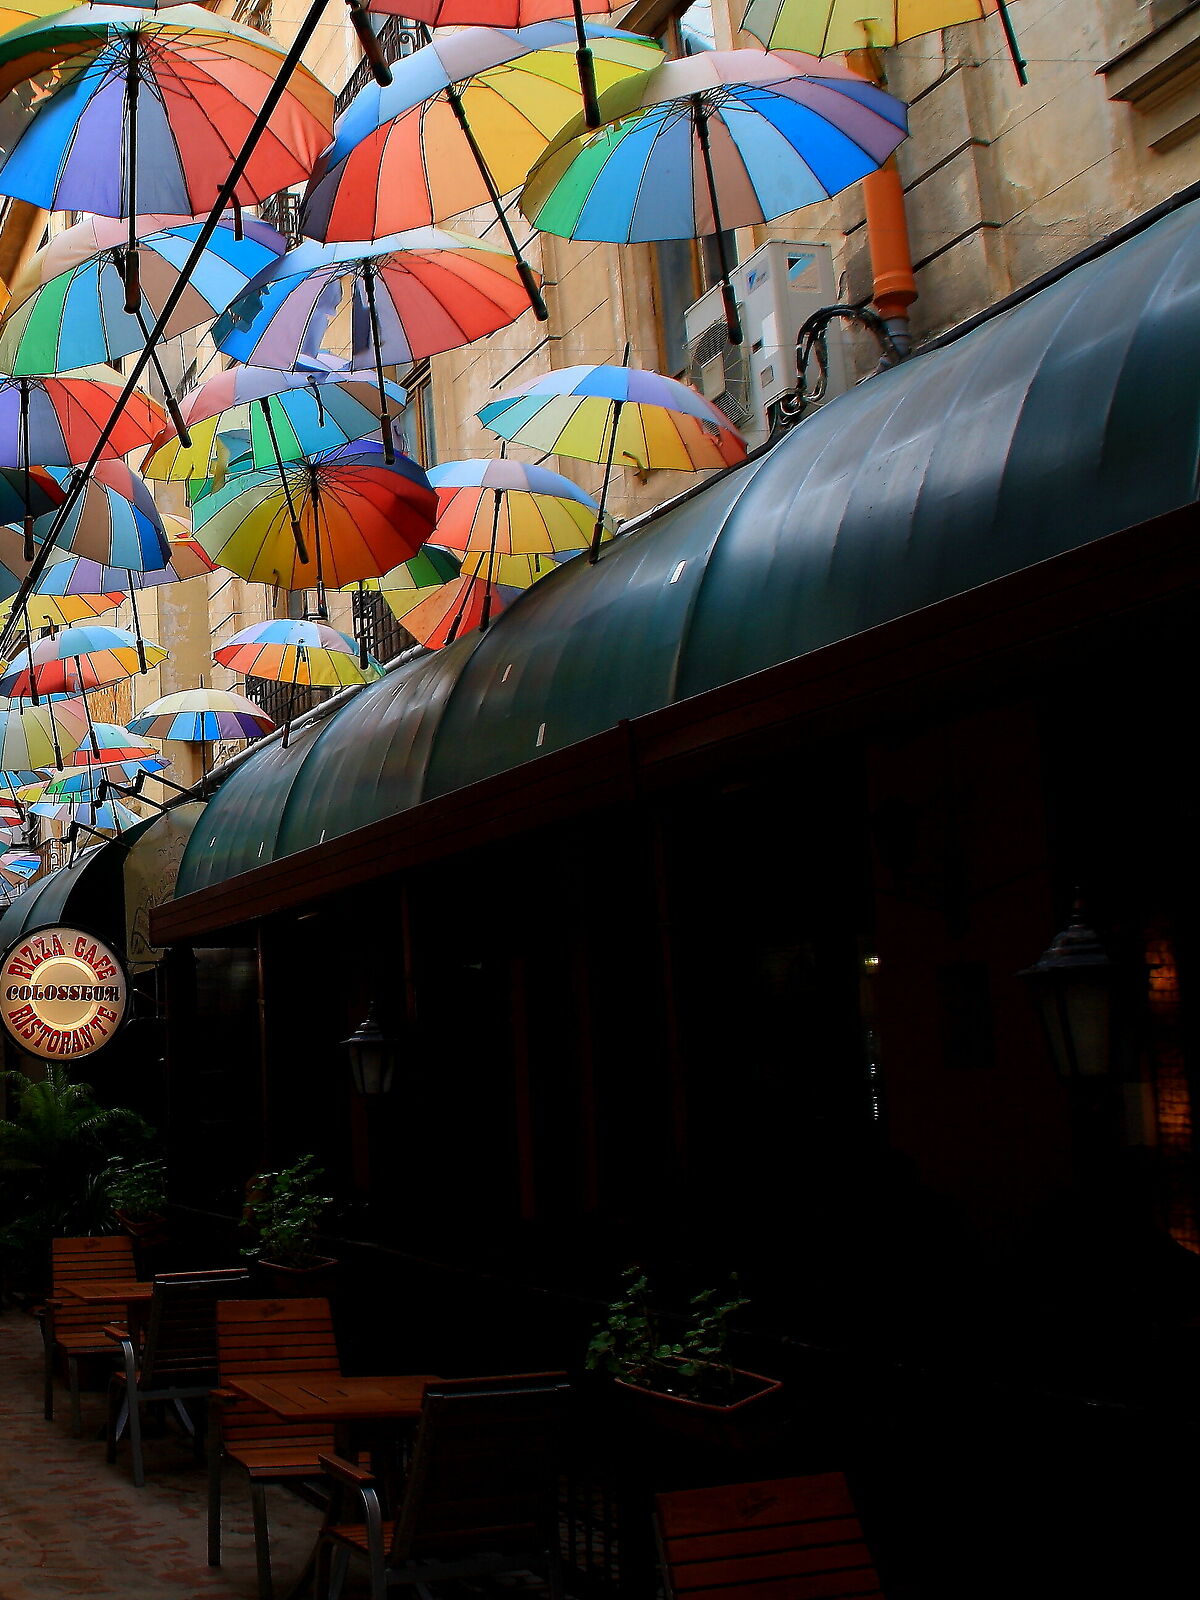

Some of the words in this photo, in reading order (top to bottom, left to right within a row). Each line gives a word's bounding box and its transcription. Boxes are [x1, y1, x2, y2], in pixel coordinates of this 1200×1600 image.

[7, 934, 66, 980] PIZZA
[74, 936, 118, 981] CAFE
[6, 984, 121, 1002] COLOSSEUM
[8, 1003, 118, 1055] RISTORANTE
